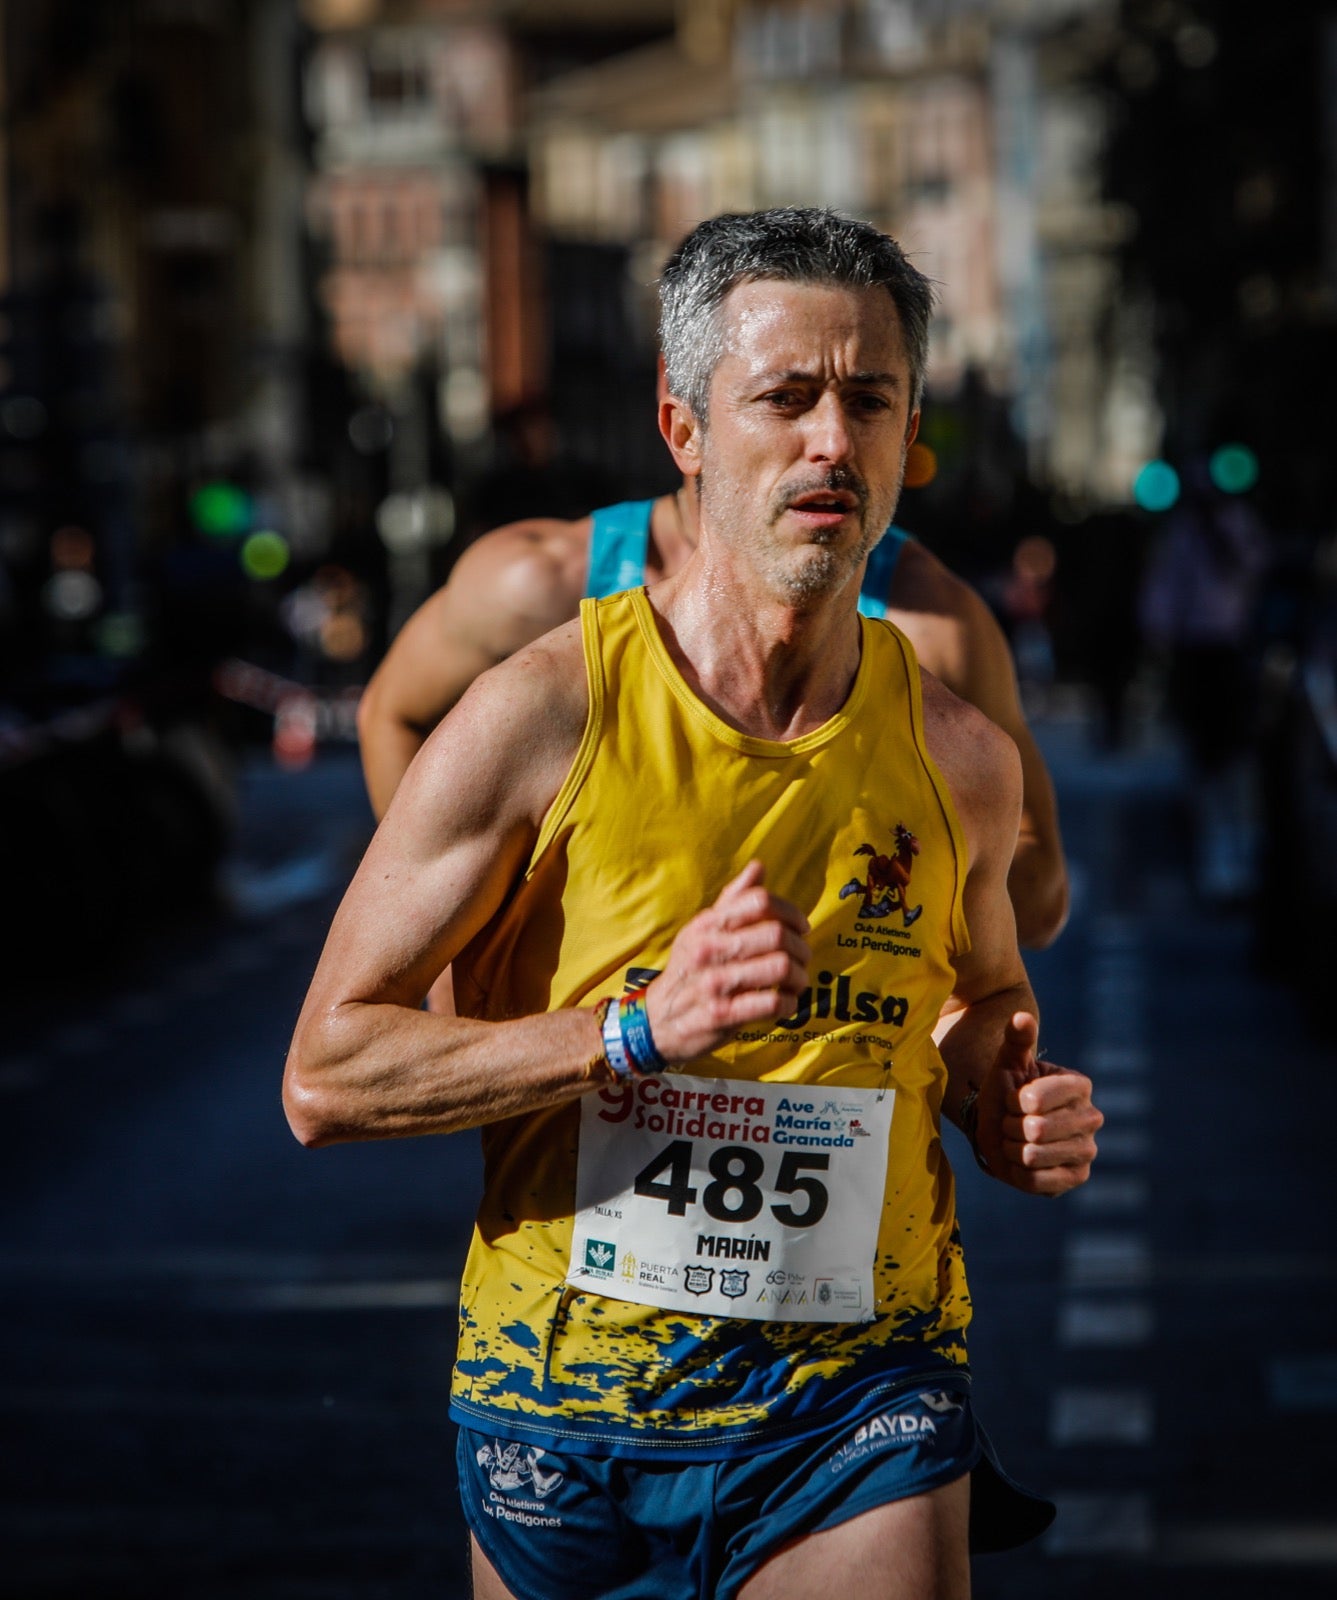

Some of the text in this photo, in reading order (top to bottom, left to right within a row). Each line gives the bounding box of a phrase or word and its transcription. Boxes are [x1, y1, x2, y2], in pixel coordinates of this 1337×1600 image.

[854, 922, 912, 939] Club Atletismo
[837, 933, 922, 957] Los Perdigones
[637, 1078, 765, 1116] Carrera
[776, 1098, 814, 1113] Ave
[634, 1105, 771, 1143] Solidaria
[775, 1114, 831, 1130] María
[772, 1130, 854, 1147] Granada
[634, 1139, 831, 1228] 485
[696, 1233, 771, 1262] MARÍN
[639, 1271, 665, 1285] REAL
[640, 1261, 679, 1277] PUERTA
[854, 1413, 937, 1447] BAYDA
[496, 1505, 562, 1527] Perdigones
